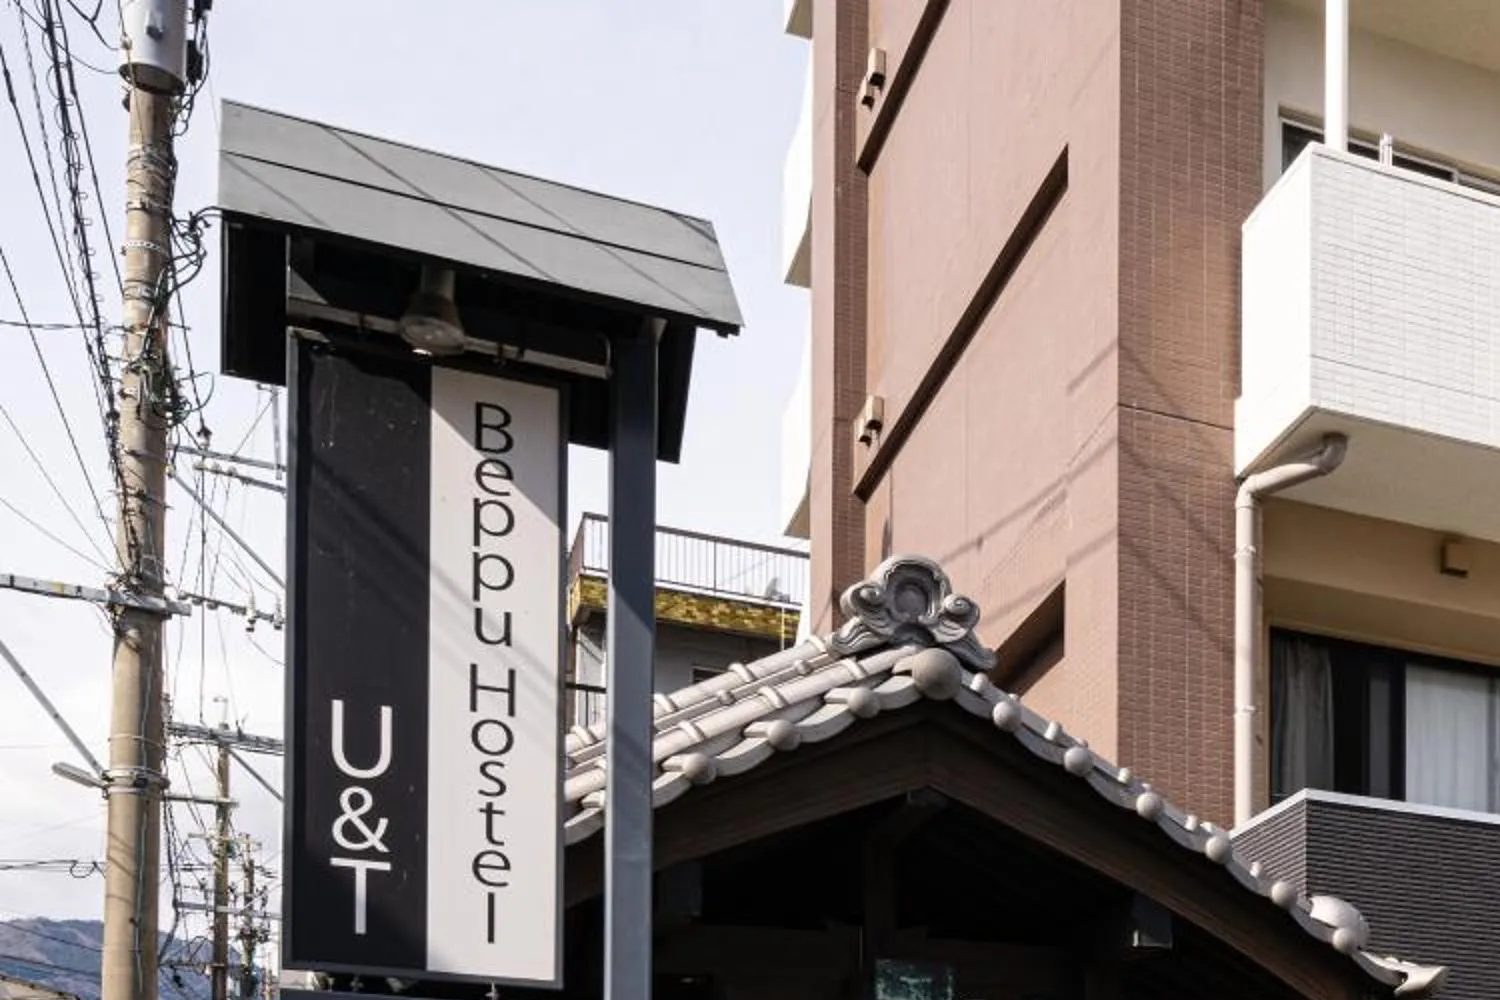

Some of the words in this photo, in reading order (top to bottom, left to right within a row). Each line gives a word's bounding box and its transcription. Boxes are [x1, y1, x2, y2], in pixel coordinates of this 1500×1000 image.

[472, 401, 516, 648] Beppu
[329, 698, 394, 935] U&T
[469, 662, 516, 944] Hostel
